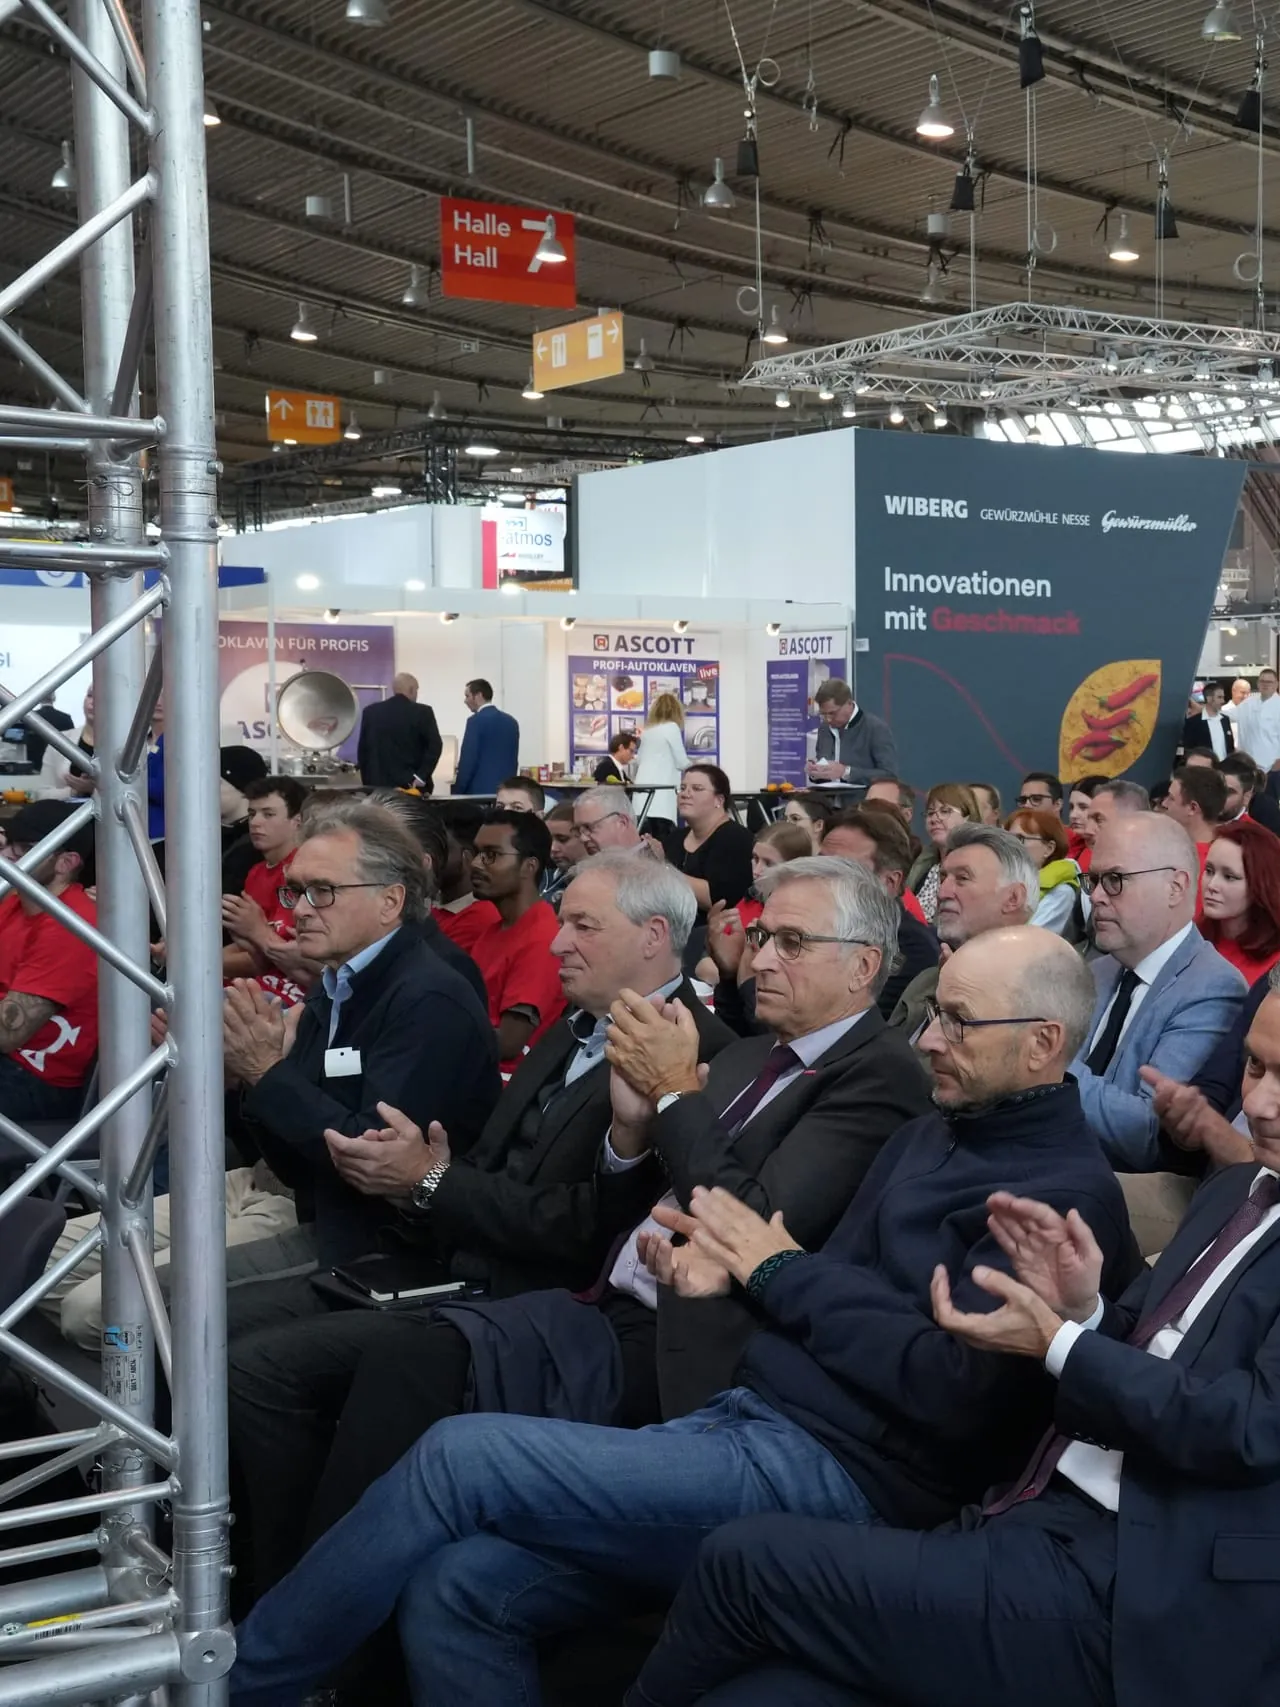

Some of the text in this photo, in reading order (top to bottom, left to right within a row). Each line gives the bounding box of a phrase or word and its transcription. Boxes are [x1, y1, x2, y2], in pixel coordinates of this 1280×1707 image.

[454, 210, 511, 237] Halle
[454, 244, 498, 269] Hall
[521, 219, 554, 273] 7
[885, 495, 1197, 532] WIBERG GEWÜRZMÜHLE NESSE Gewürzmüller
[885, 567, 1051, 597] Innovationen
[885, 606, 1081, 635] mit Geschmack
[289, 635, 316, 650] FÜR
[320, 638, 369, 652] PROFIS
[614, 635, 696, 654] ASCOTT
[789, 636, 832, 655] ASCOTT
[593, 660, 696, 673] PROFI-AUTOKLAVEN
[700, 667, 718, 679] live
